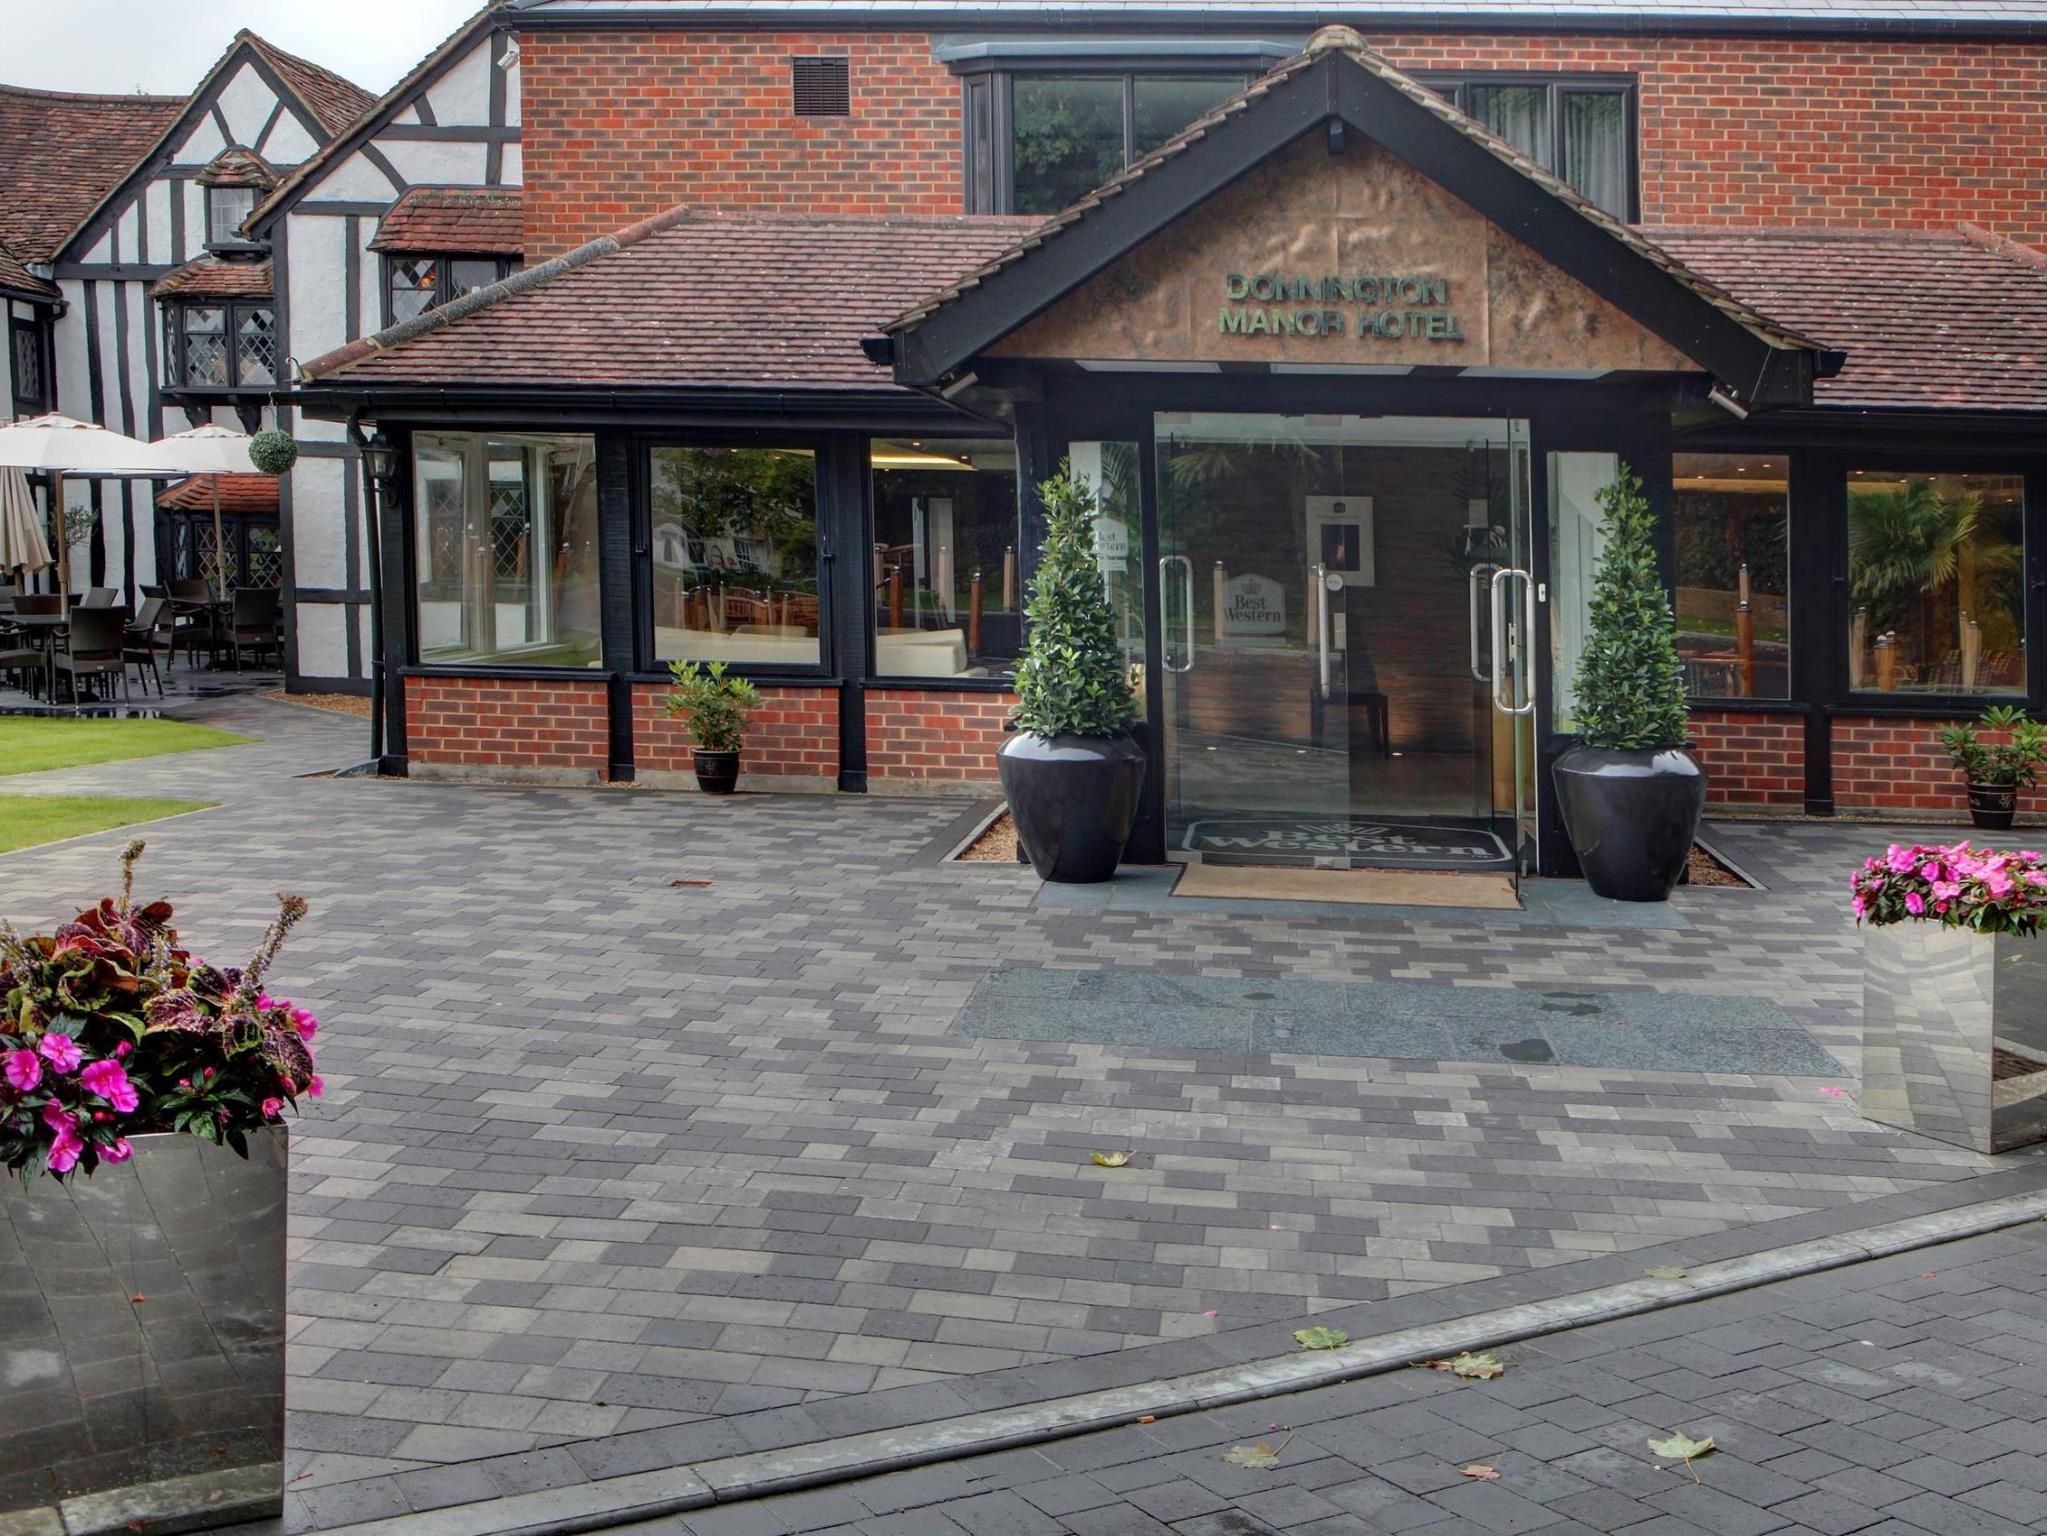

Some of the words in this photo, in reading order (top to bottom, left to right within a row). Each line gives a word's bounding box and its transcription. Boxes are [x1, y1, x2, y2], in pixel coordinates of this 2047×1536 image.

[1226, 274, 1448, 304] DONNINGTON
[1219, 307, 1345, 336] MANOR
[1358, 311, 1464, 339] HOTEL
[1235, 595, 1265, 609] Best
[1224, 608, 1281, 622] Western
[1264, 830, 1417, 844] Best
